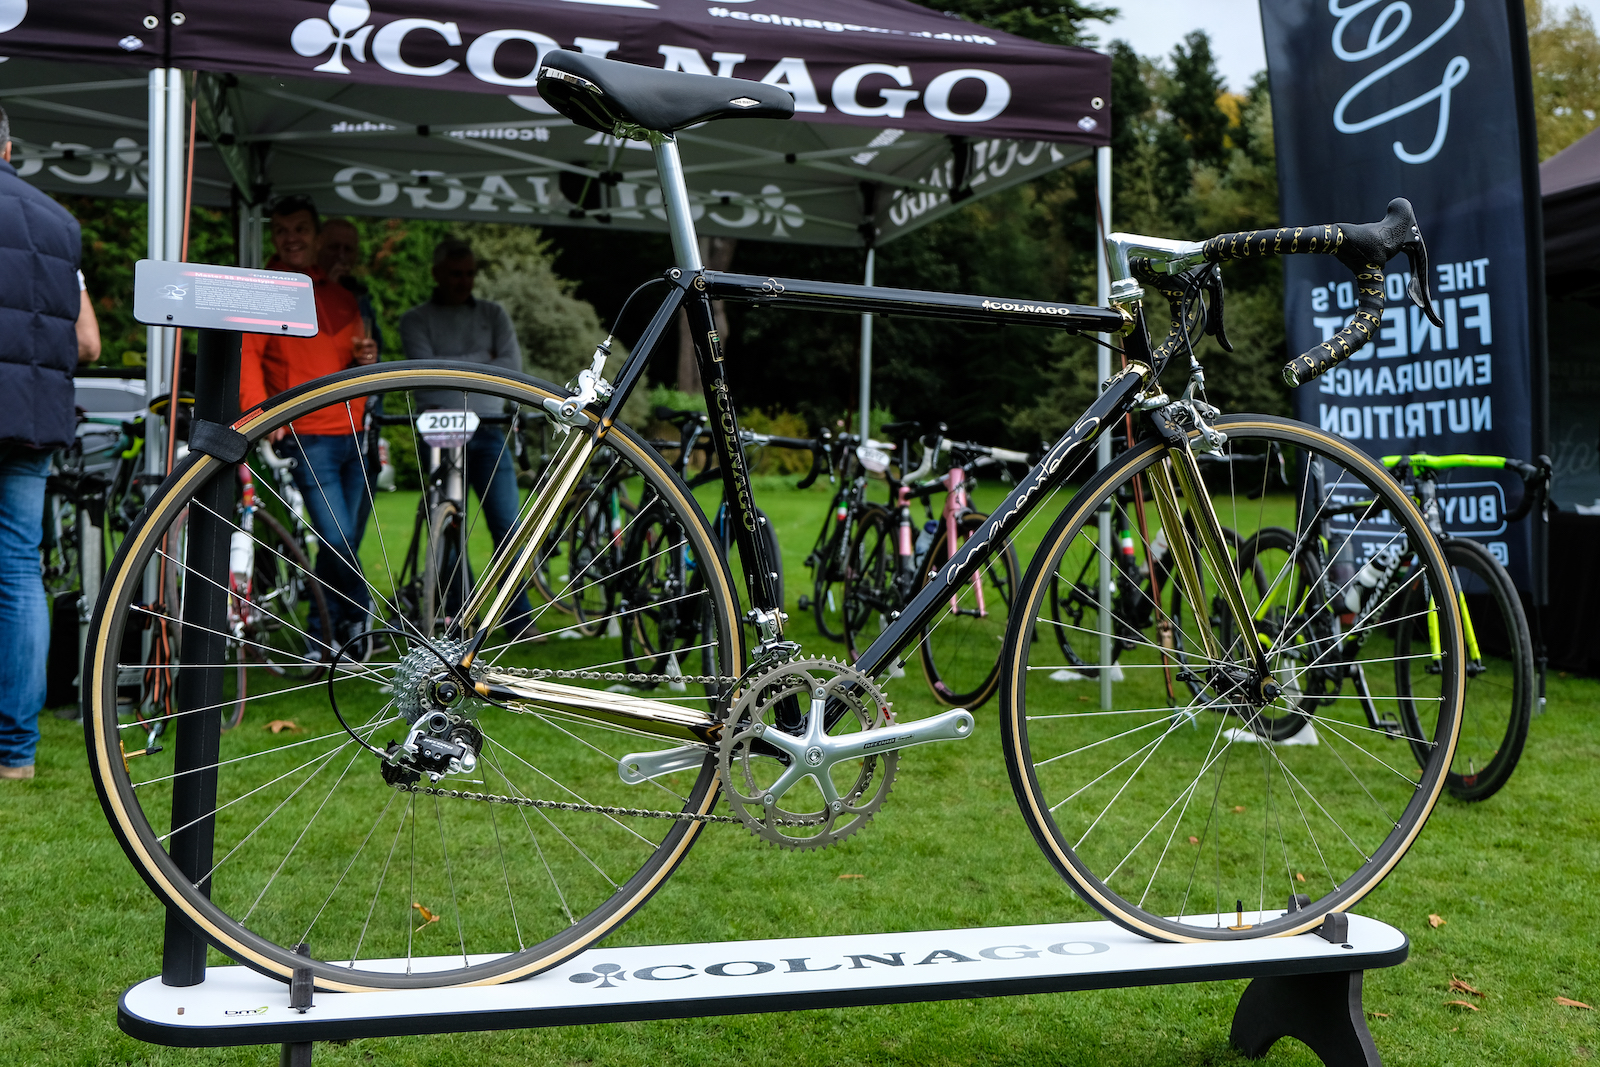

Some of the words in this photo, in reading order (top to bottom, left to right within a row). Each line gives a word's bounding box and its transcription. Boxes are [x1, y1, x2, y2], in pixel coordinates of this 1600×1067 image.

[195, 272, 223, 280] Master
[236, 276, 275, 285] Prototype
[990, 302, 1070, 316] COLNAGO
[429, 416, 467, 429] 2017
[716, 391, 756, 532] COLNAGO
[632, 940, 1112, 982] COLNAGO
